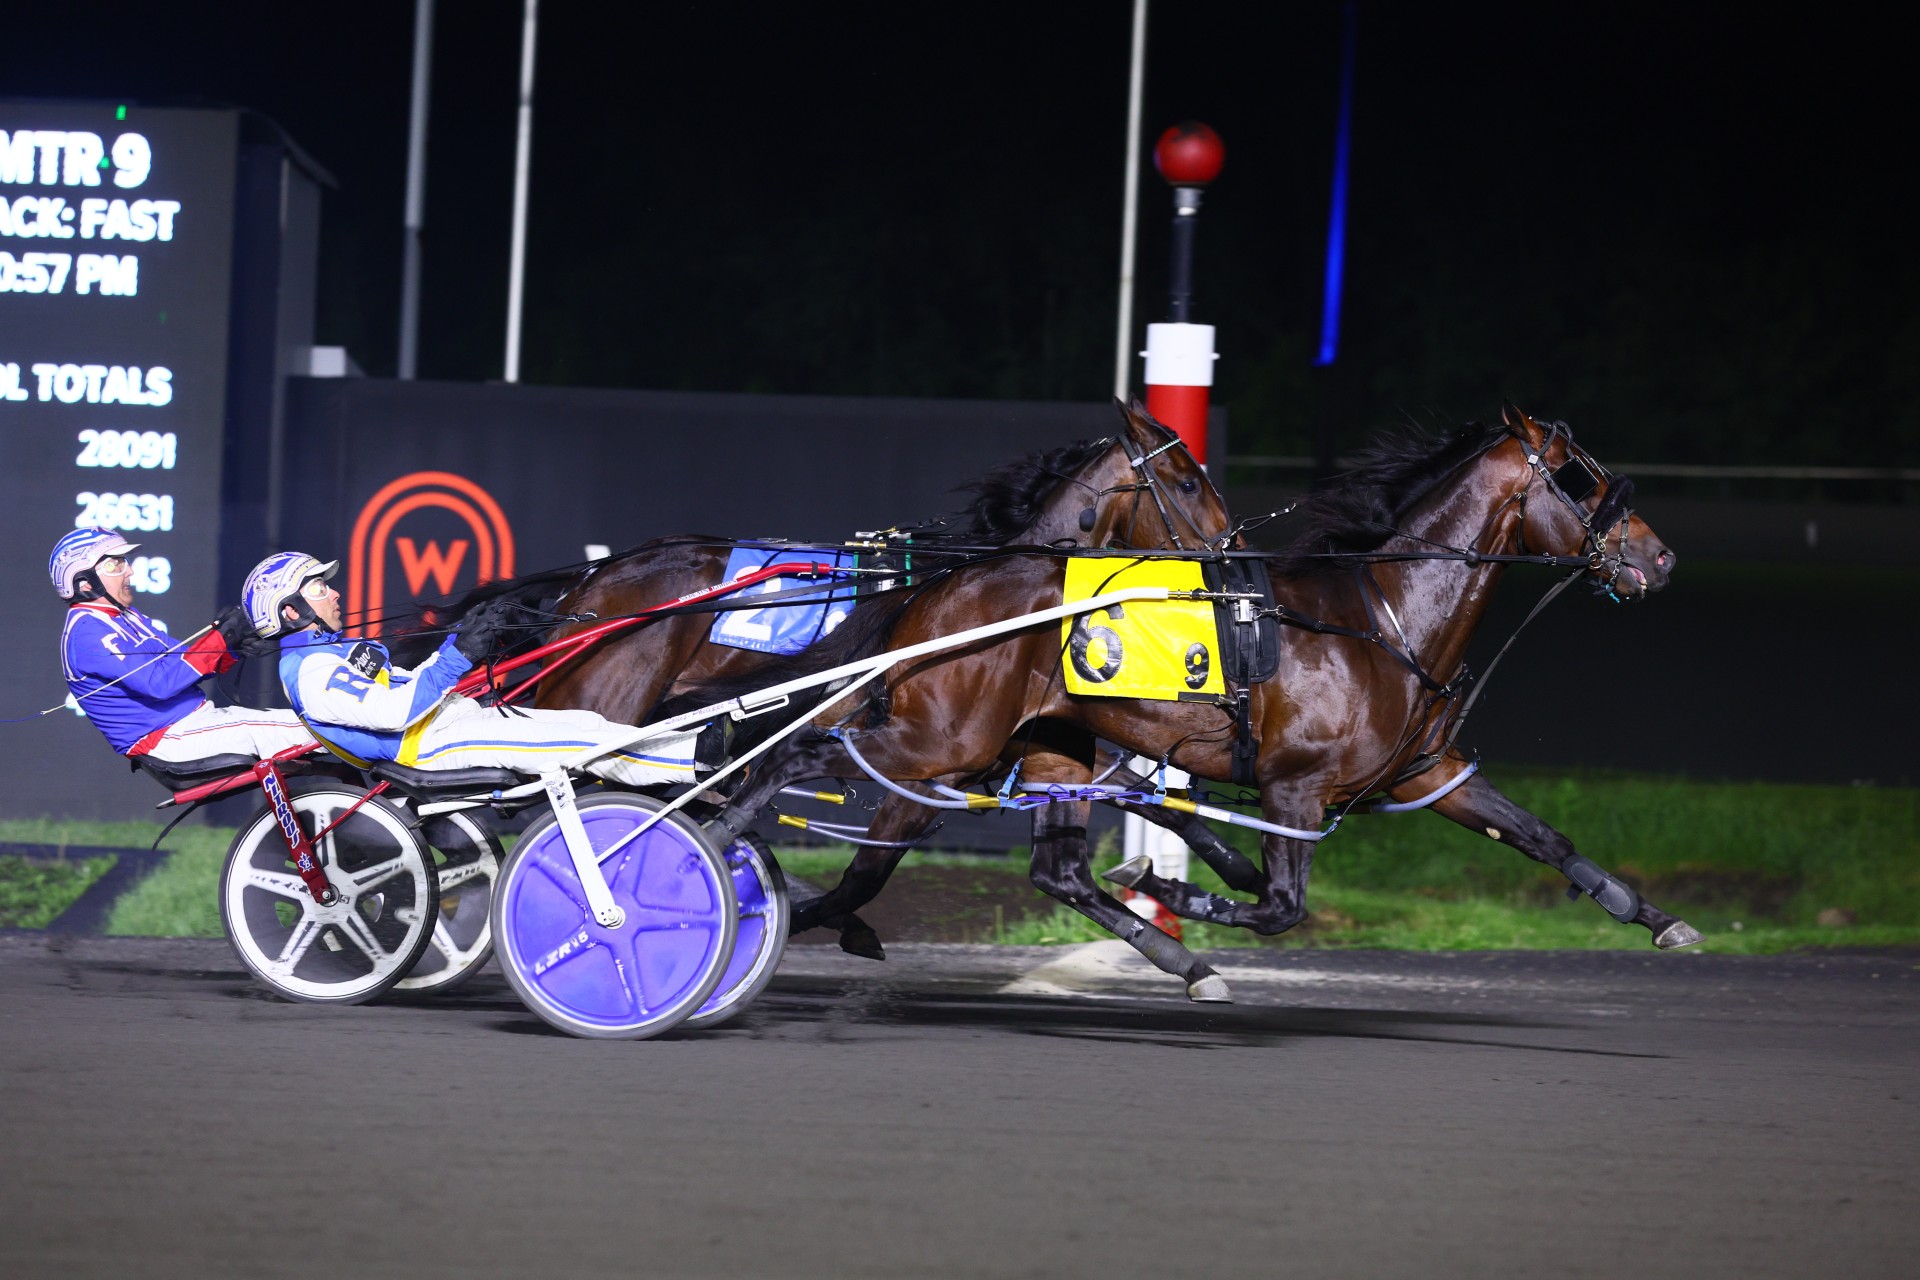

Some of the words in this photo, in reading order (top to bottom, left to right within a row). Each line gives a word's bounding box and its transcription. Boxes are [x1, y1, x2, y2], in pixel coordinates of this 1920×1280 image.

[112, 133, 151, 189] 9
[80, 198, 181, 242] FAST
[76, 253, 138, 296] PM
[32, 363, 173, 406] TOTALS
[76, 429, 177, 469] 28091
[75, 491, 174, 532] 26631
[396, 536, 469, 597] W
[720, 565, 782, 641] 2
[101, 633, 125, 661] F
[1070, 602, 1124, 683] 6
[325, 665, 375, 703] R
[1185, 642, 1209, 689] 9
